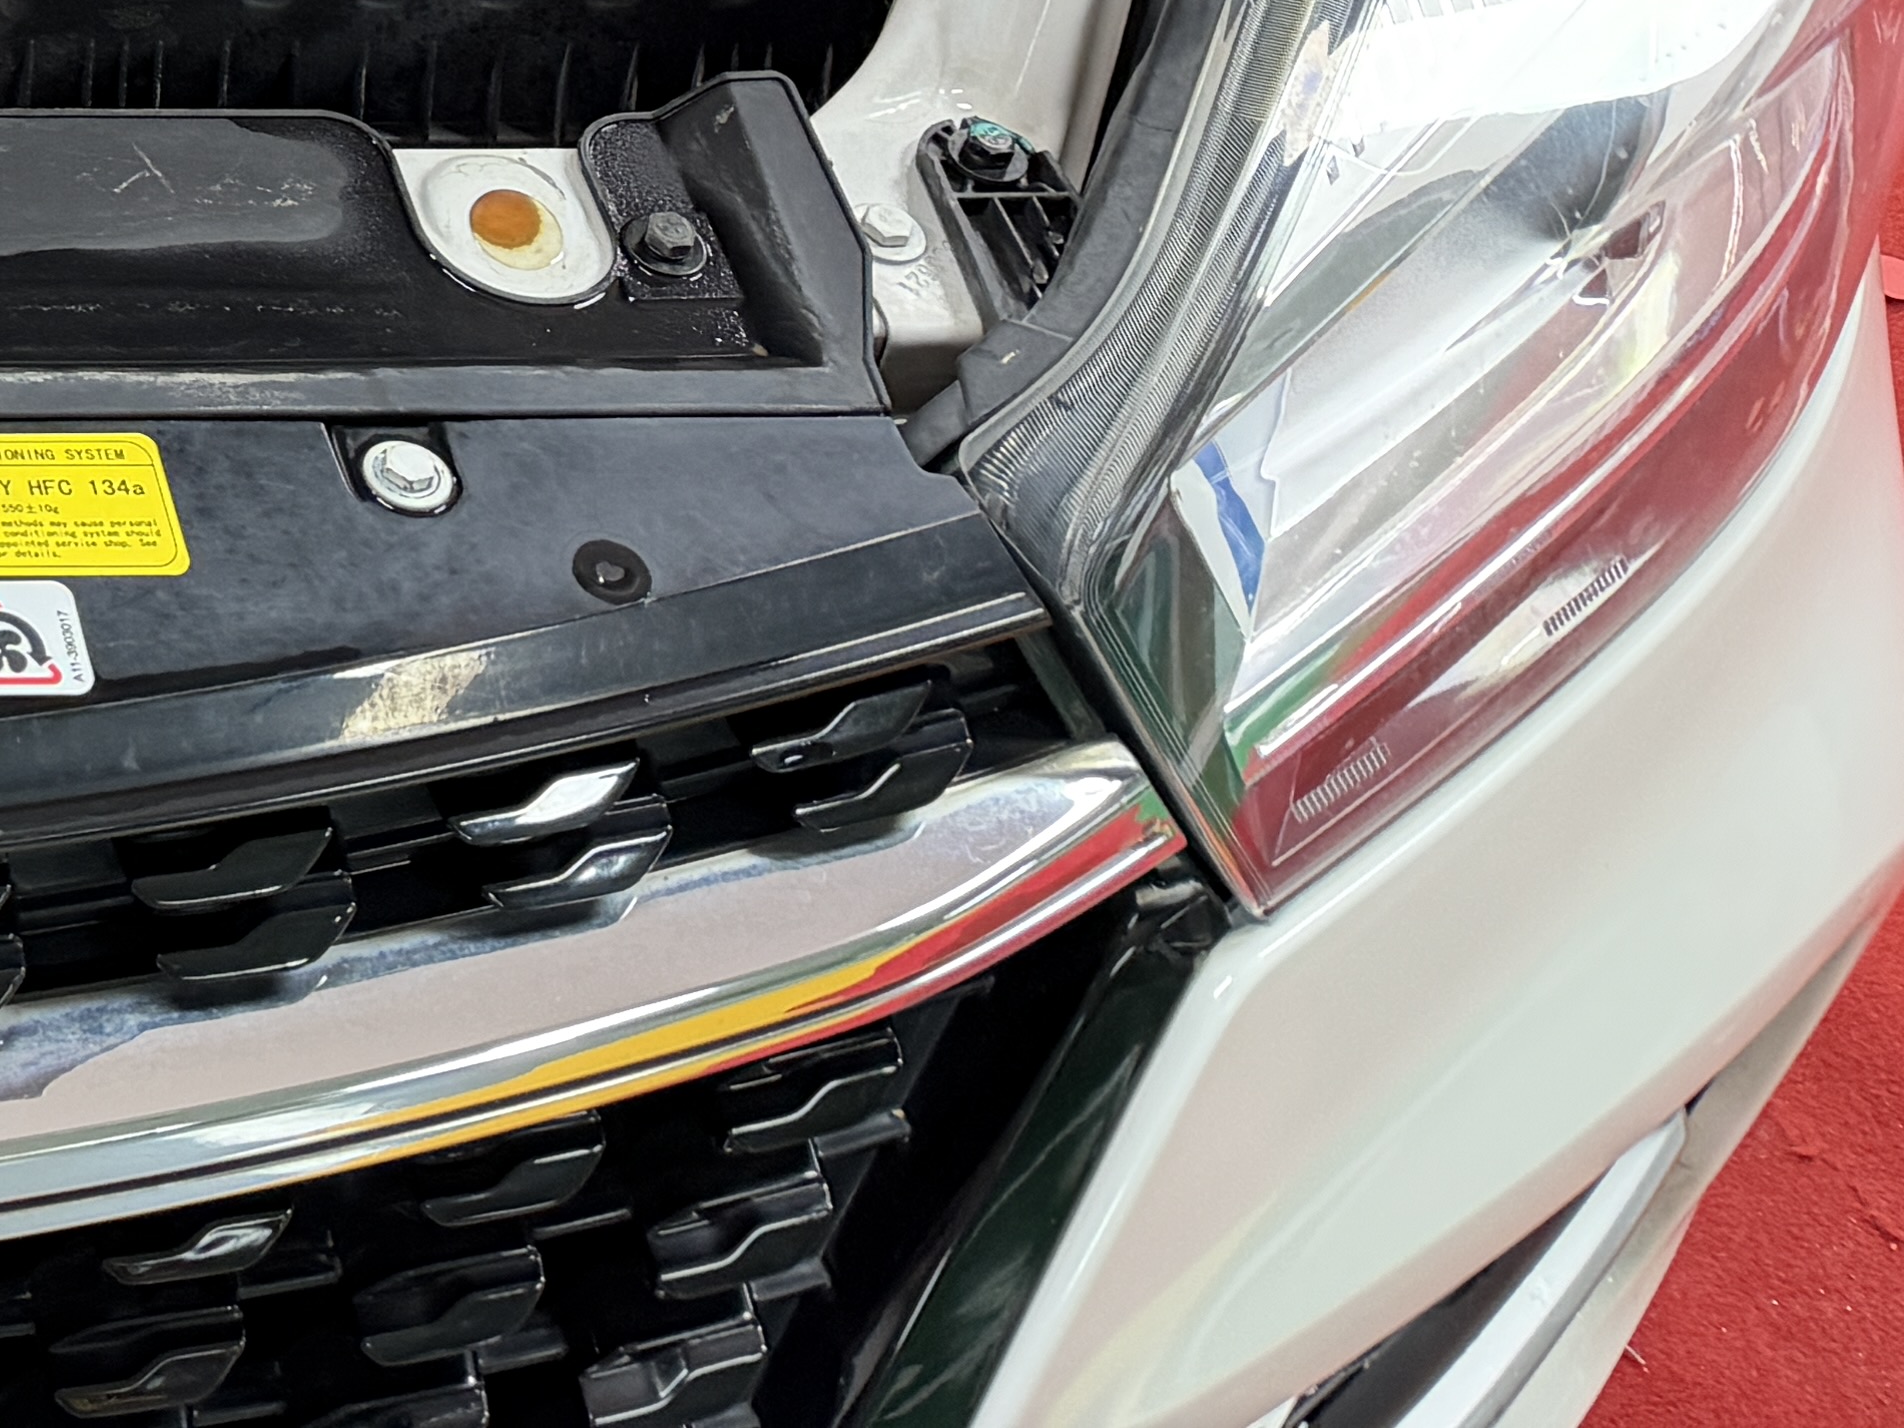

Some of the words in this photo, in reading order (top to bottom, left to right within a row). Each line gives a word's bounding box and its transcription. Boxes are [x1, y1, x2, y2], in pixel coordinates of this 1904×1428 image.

[65, 449, 126, 460] SYSTEM
[28, 479, 73, 495] HFC
[89, 479, 145, 495] 134a
